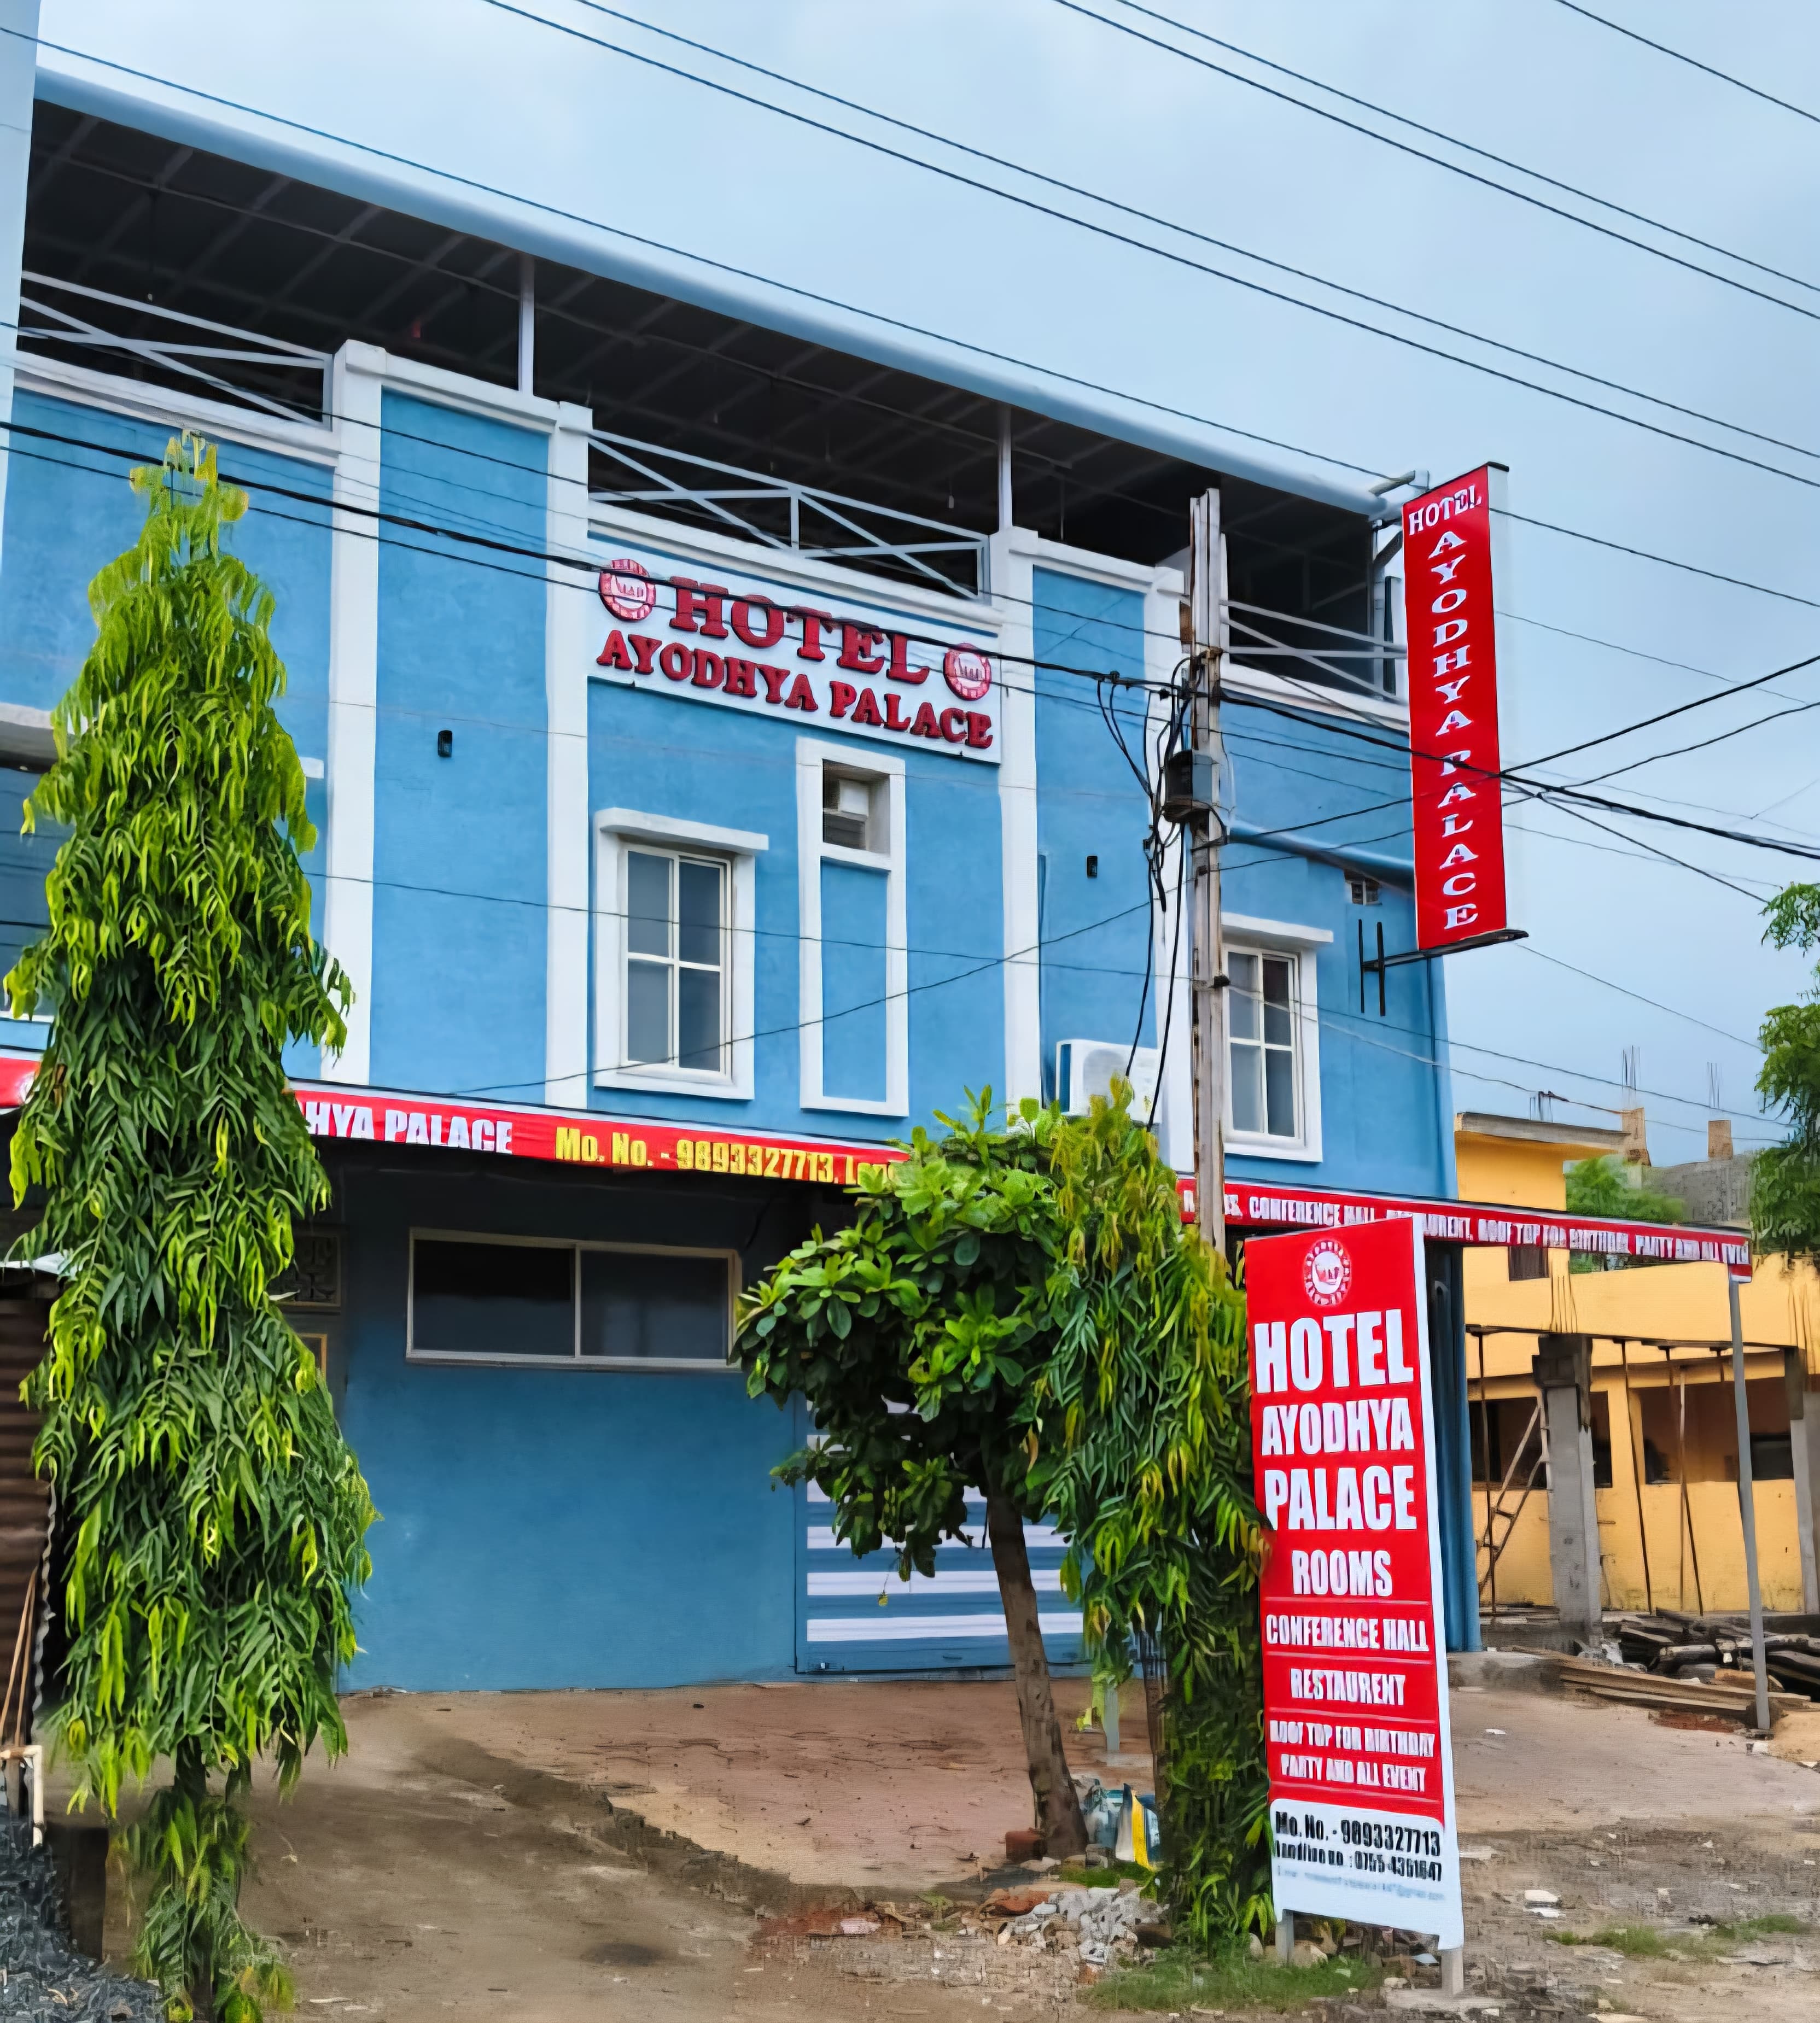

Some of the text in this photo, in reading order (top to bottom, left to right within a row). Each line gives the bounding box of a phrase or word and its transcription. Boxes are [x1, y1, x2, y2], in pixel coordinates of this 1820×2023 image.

[669, 576, 929, 684] HOTEL
[1427, 530, 1473, 736] AYODHYA
[597, 630, 993, 749] AYODHYA PALACE
[384, 1109, 512, 1155] PALACE
[556, 1127, 604, 1162] Mo.
[612, 1132, 653, 1167] No.
[1254, 1309, 1414, 1393] HOTEL
[1262, 1398, 1415, 1455] AYODHYA
[1264, 1465, 1417, 1530] PALACE
[1292, 1550, 1393, 1597] ROOMS
[1266, 1614, 1430, 1652] CONFERENCE HALL
